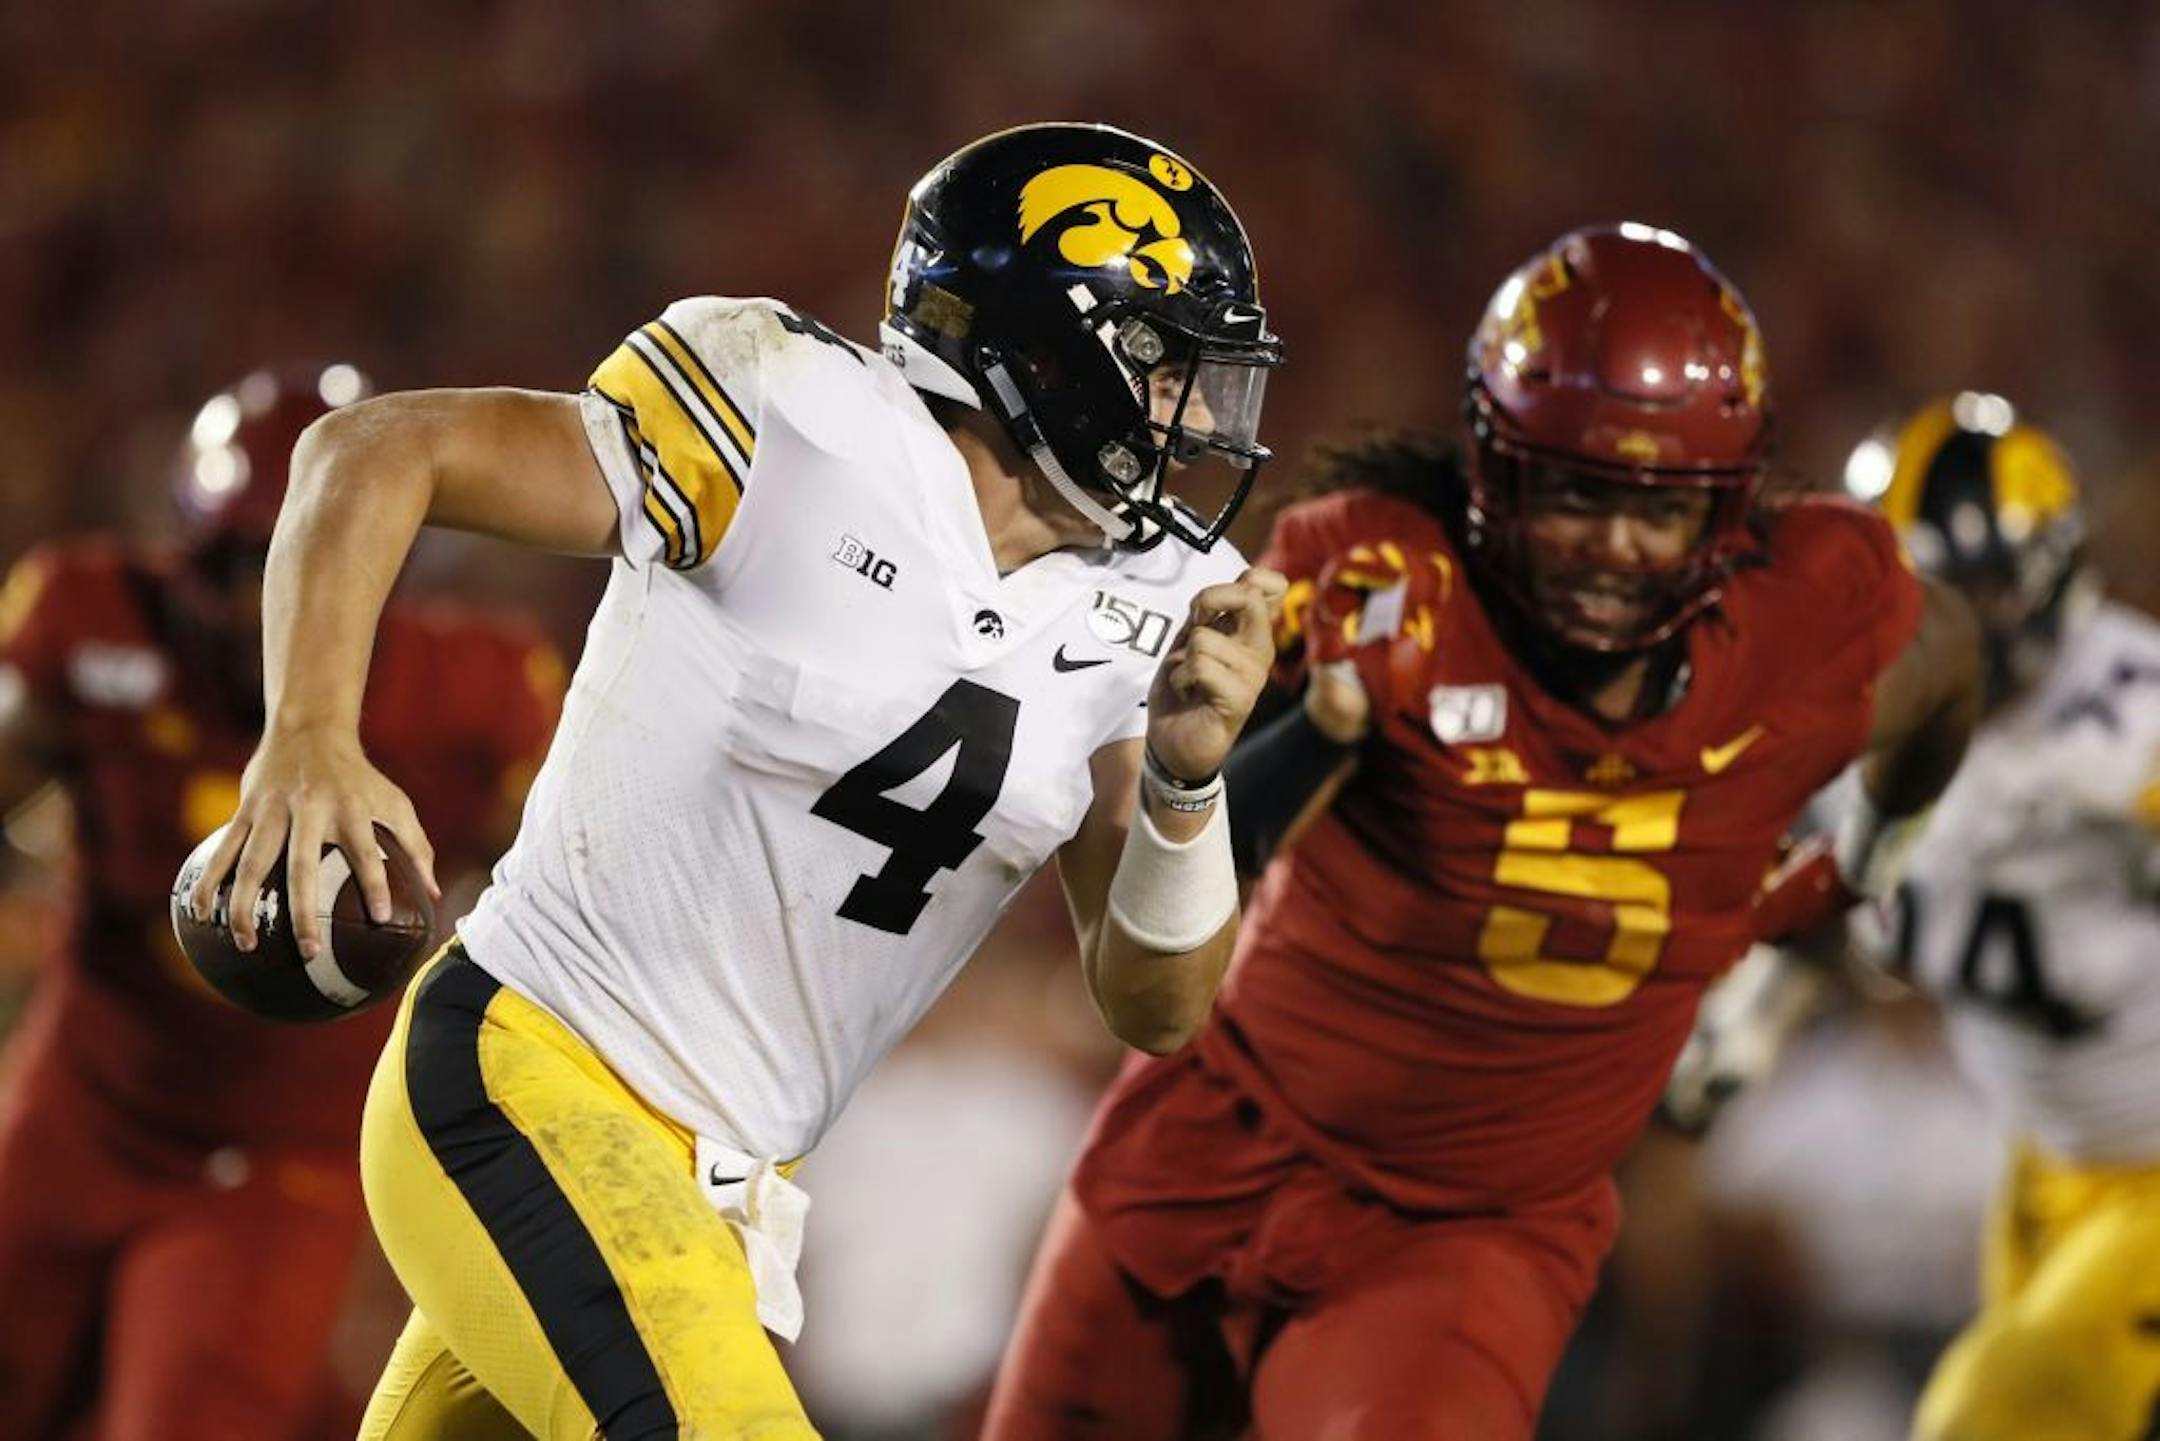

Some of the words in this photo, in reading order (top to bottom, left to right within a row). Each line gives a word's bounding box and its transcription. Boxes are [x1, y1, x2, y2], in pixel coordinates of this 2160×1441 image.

[1093, 591, 1173, 658] 150
[810, 677, 1021, 935] 4
[1478, 789, 1686, 1008] 5
